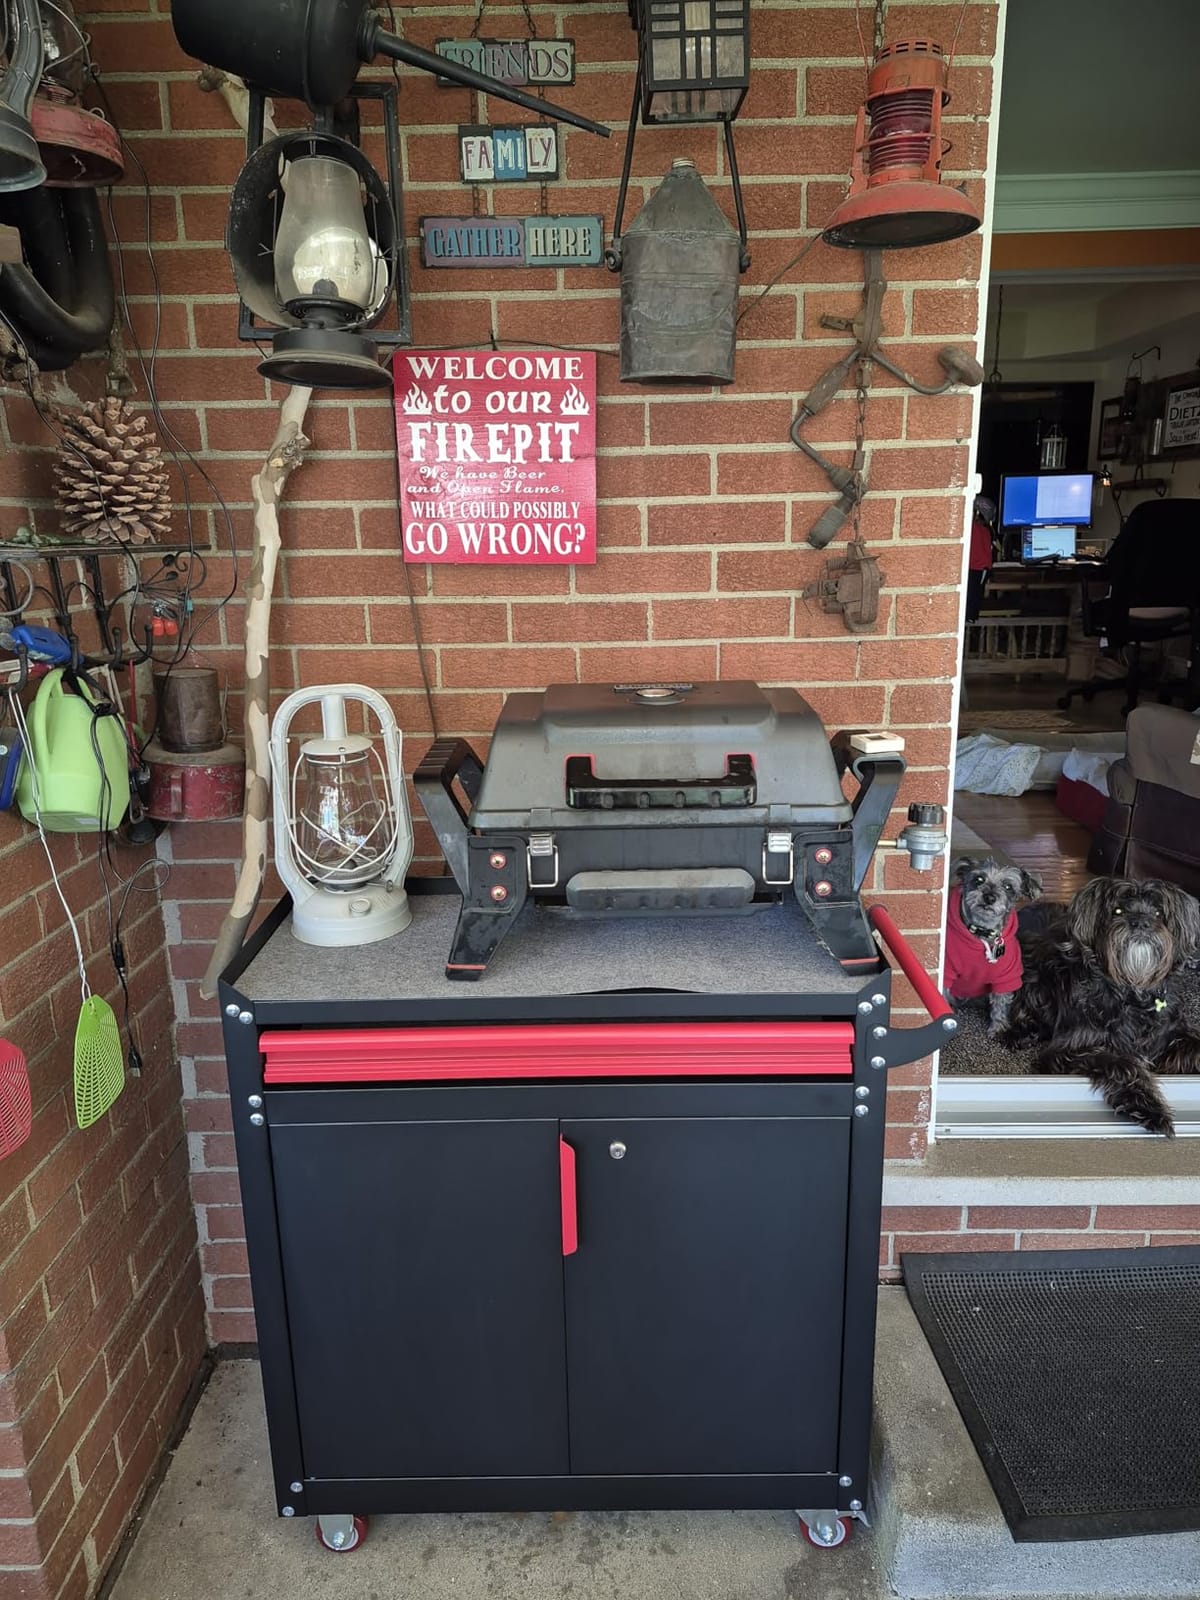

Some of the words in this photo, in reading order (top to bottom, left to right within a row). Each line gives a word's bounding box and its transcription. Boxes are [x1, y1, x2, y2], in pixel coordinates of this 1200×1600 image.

[463, 137, 552, 171] FAMILY
[428, 227, 522, 257] GATHER
[529, 227, 592, 257] HERE
[406, 356, 584, 380] WELCOME
[407, 421, 579, 464] FIREPIT
[419, 466, 448, 480] We
[455, 466, 498, 480] have
[503, 466, 546, 480] Beer
[407, 481, 441, 494] and
[447, 480, 494, 498] Open
[499, 480, 565, 494] Flame.
[410, 501, 457, 519] WHAT
[460, 501, 510, 519] COULD
[513, 501, 580, 519] POSSIBLY
[405, 522, 448, 555] GO
[456, 522, 586, 555] WRONG?
